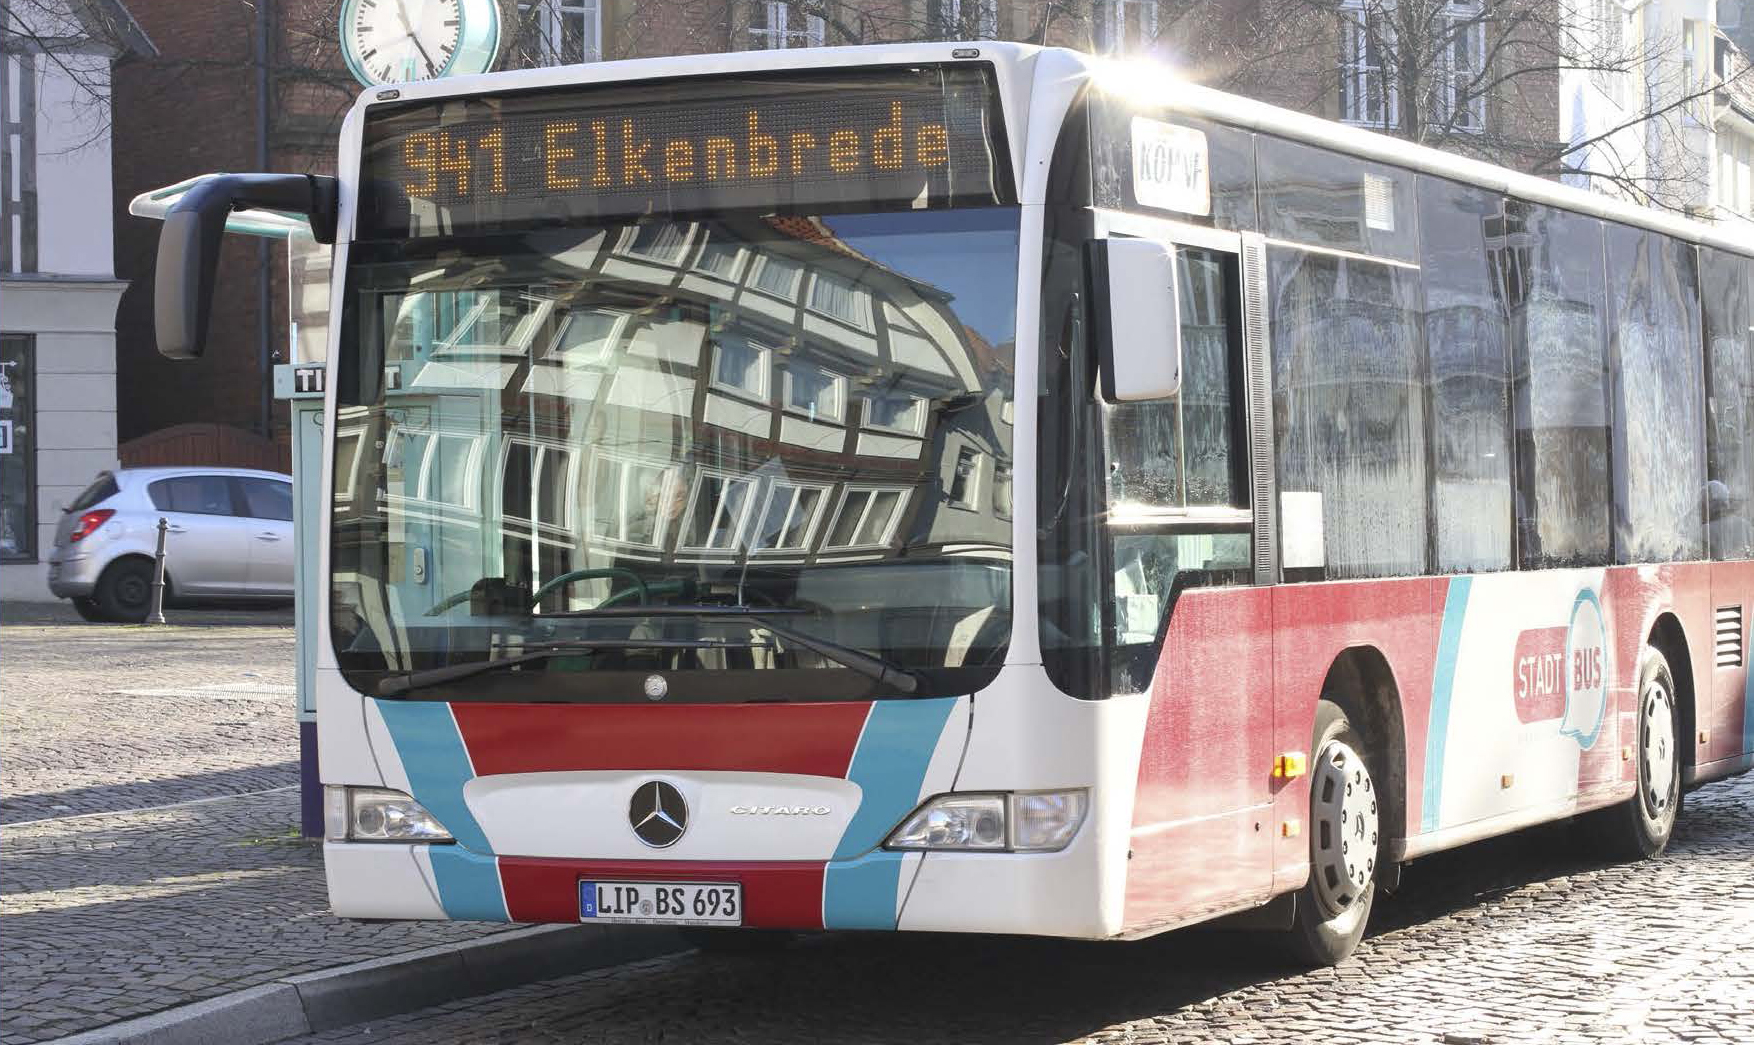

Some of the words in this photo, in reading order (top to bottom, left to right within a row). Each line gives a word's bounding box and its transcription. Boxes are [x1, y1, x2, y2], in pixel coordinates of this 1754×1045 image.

[405, 128, 506, 197] 941
[546, 101, 947, 189] Elkenbrede
[1519, 653, 1563, 699] STADT
[1574, 647, 1601, 691] BUS
[729, 805, 832, 815] CITARO
[598, 886, 639, 914] LIP
[656, 888, 684, 915] BS
[693, 889, 736, 916] 693
